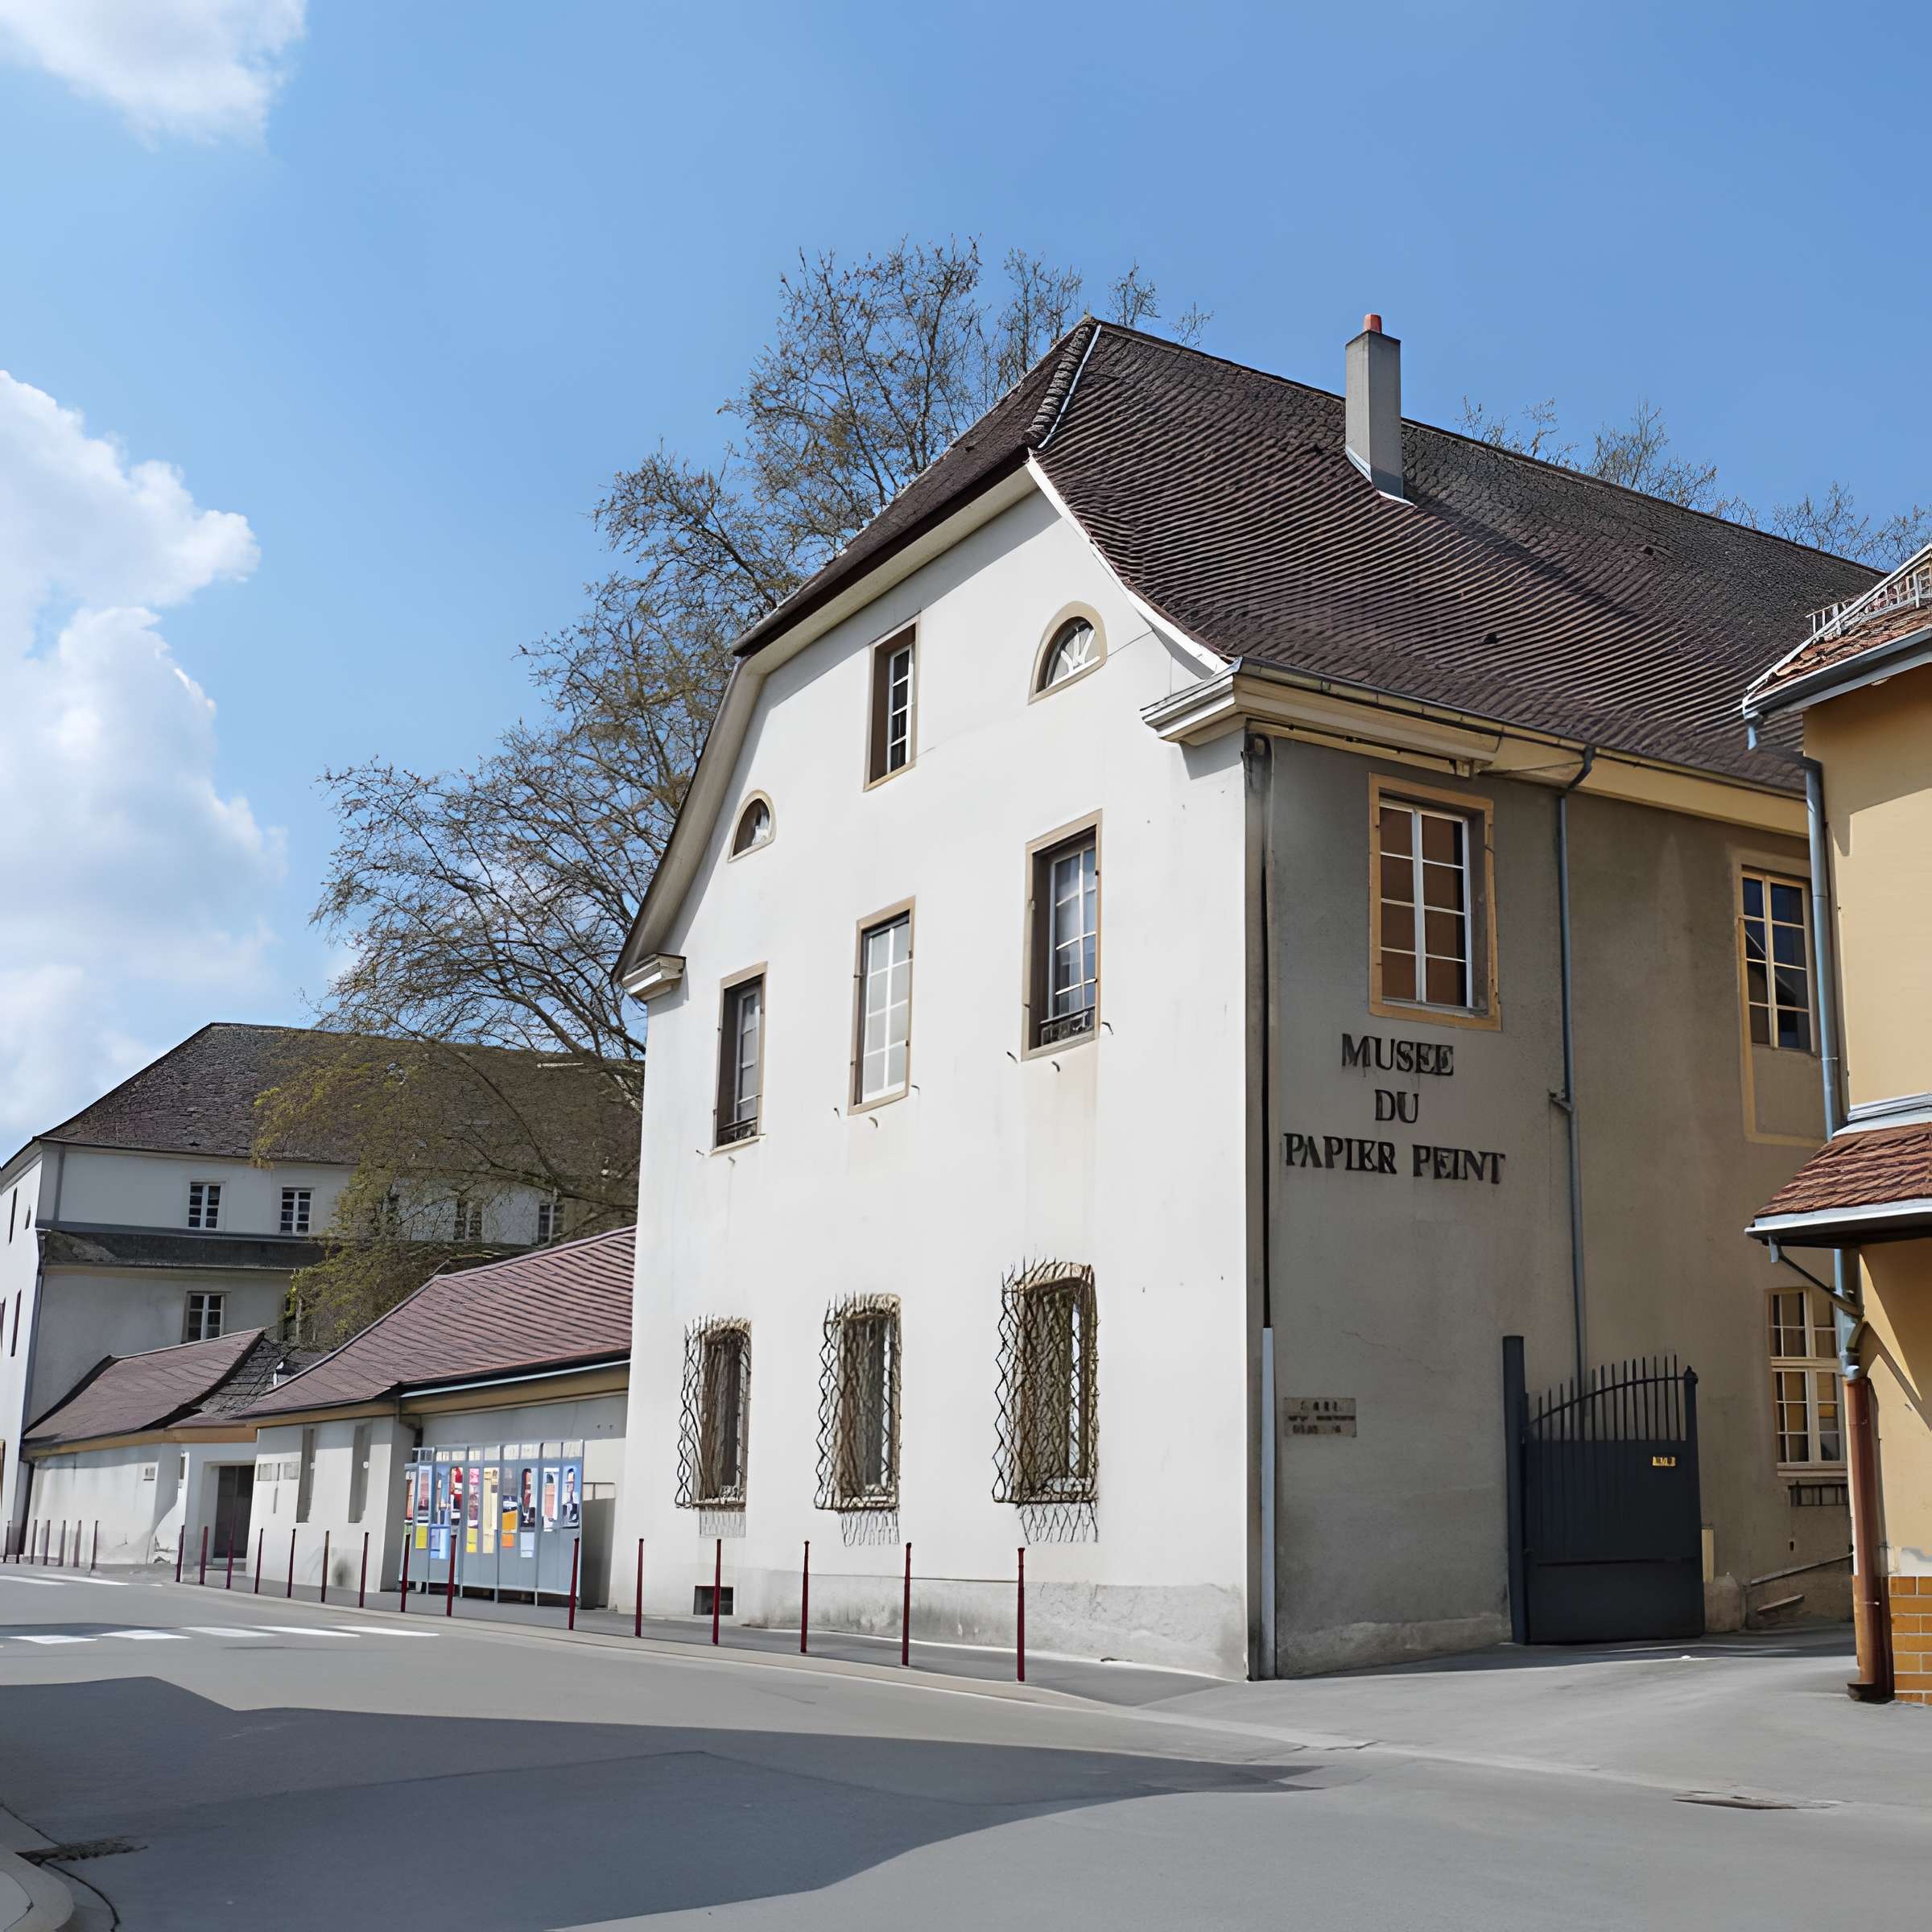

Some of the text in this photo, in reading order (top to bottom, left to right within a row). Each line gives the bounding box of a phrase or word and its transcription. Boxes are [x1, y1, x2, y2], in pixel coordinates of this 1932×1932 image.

[1341, 1033, 1454, 1075] MUSEE
[1375, 1089, 1419, 1124] DU
[1283, 1133, 1506, 1184] PAPIER PEINT
